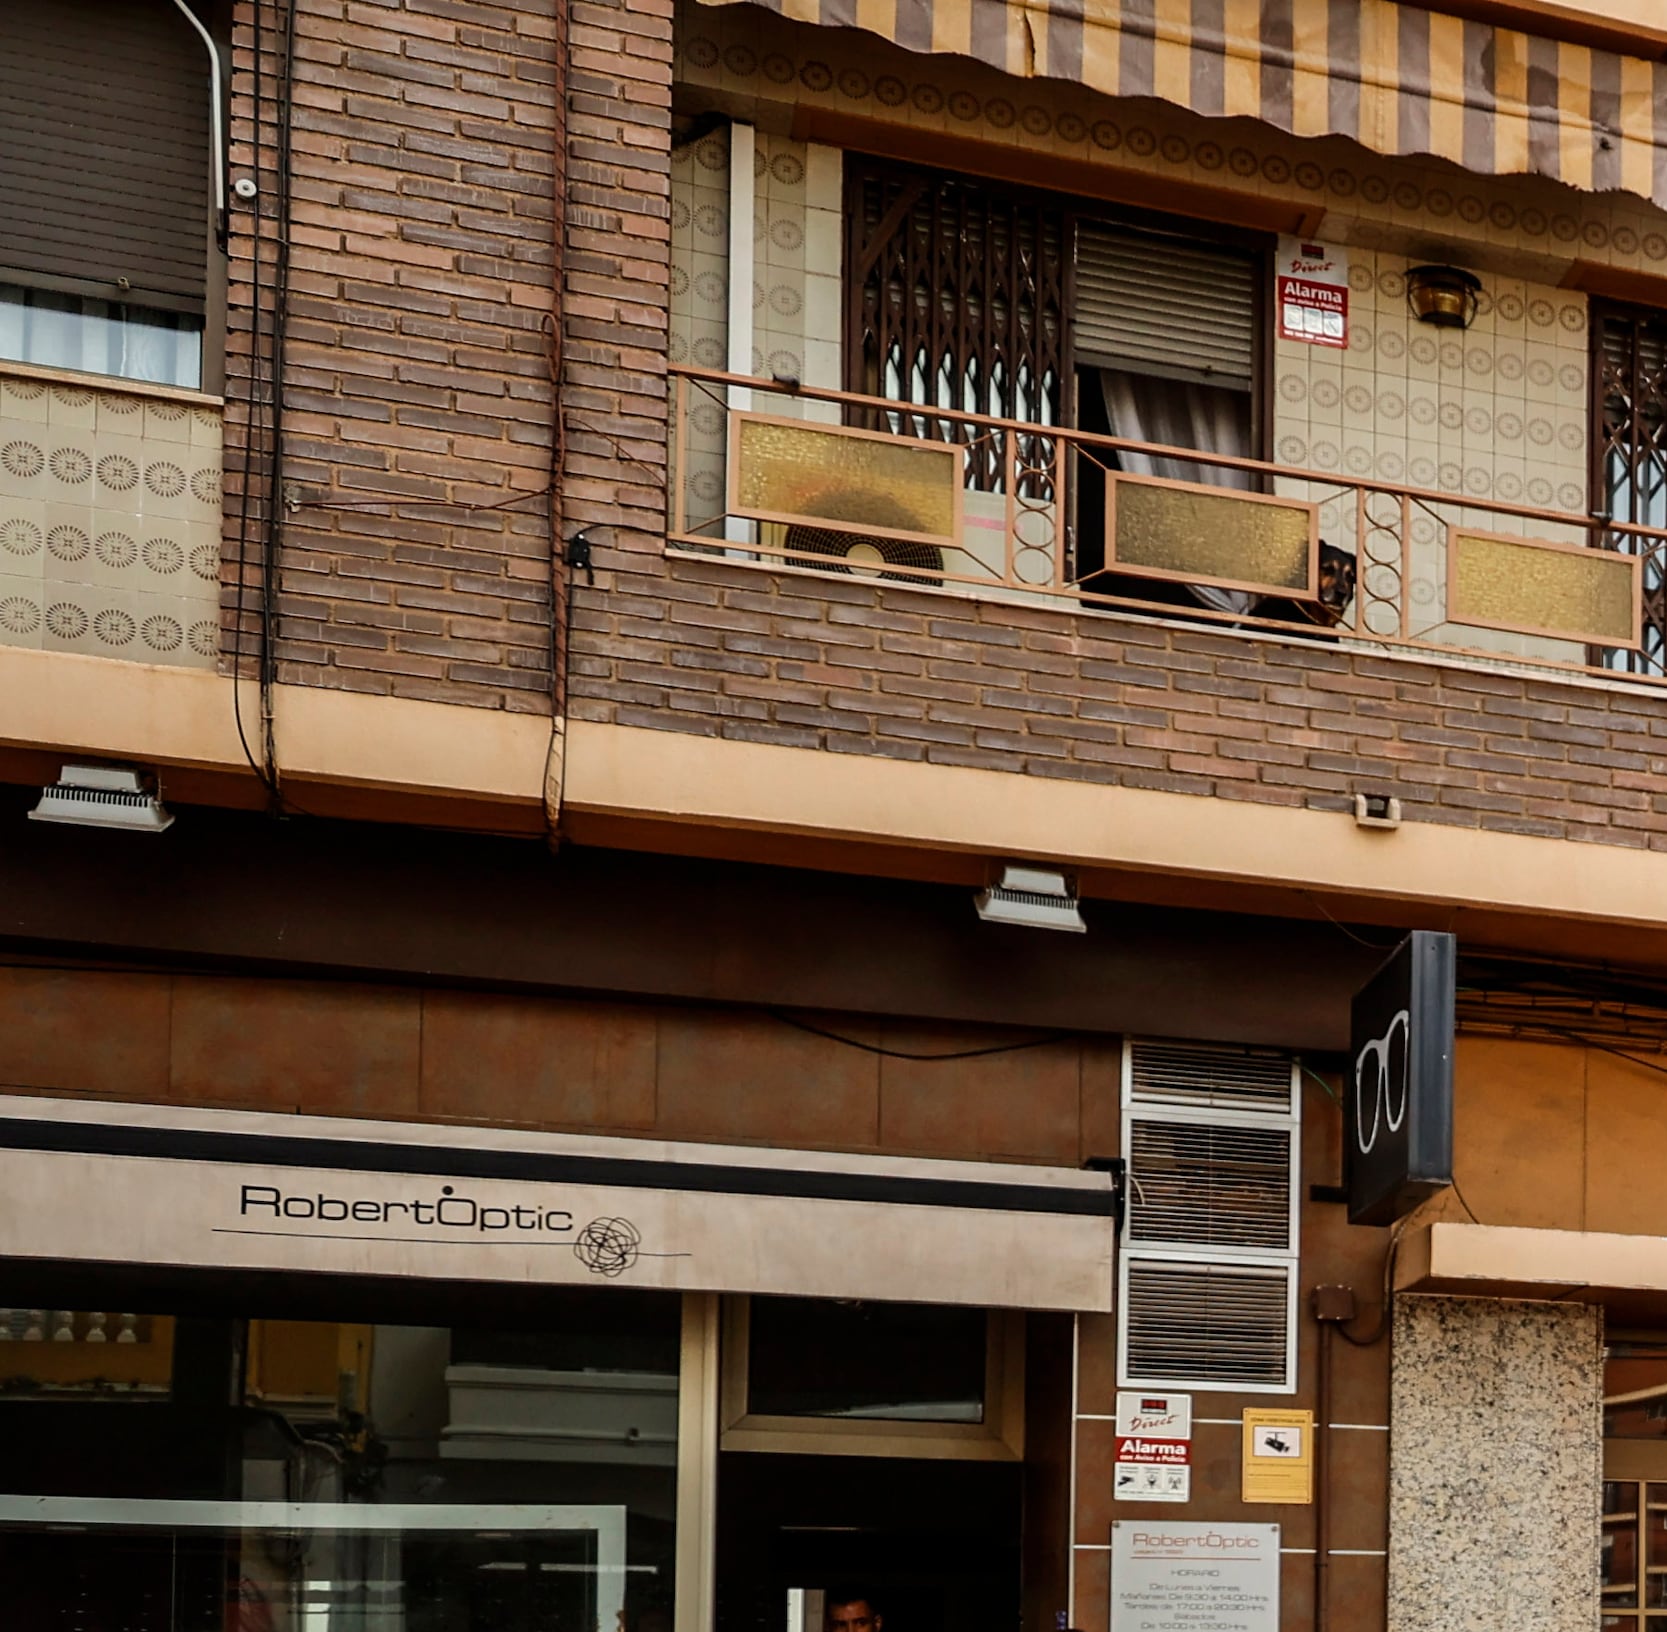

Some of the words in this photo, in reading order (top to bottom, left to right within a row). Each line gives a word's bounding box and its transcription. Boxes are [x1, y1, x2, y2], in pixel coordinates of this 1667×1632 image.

[1284, 281, 1343, 303] Alarma
[1120, 1439, 1187, 1456] Alarma
[1170, 1569, 1220, 1577] HORARIO
[1204, 1584, 1241, 1592] Viernes
